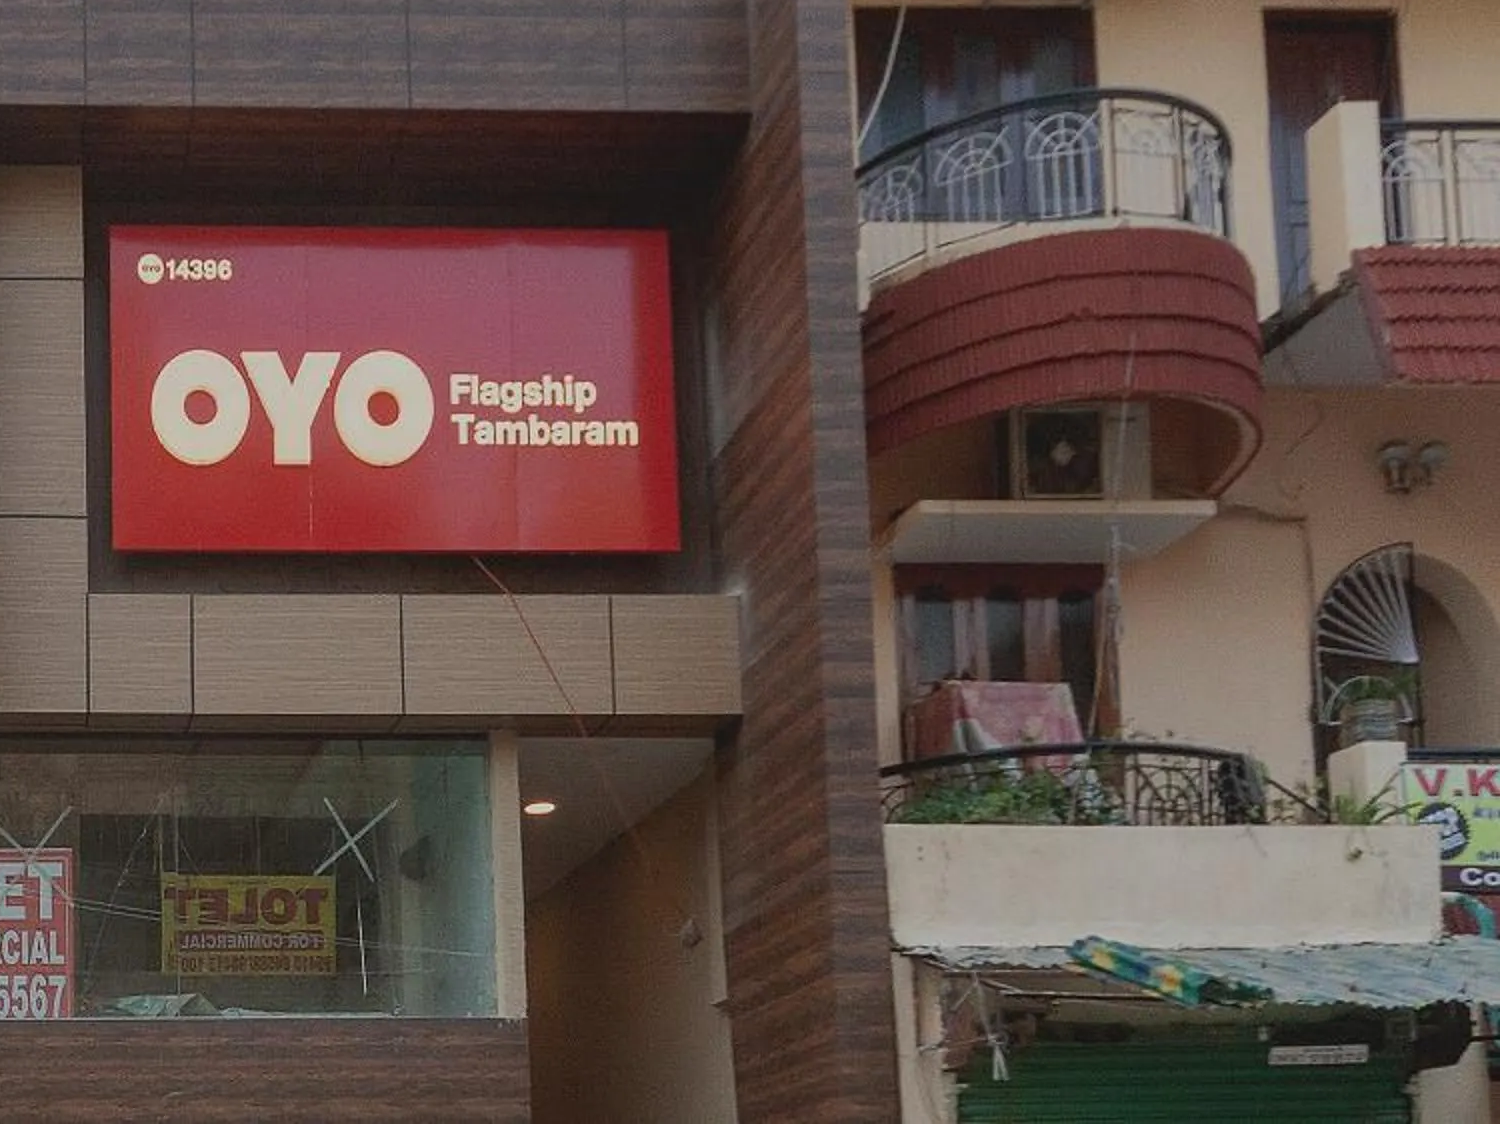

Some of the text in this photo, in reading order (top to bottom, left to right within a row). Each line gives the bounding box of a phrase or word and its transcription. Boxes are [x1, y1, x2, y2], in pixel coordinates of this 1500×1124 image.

[166, 259, 232, 280] 14396
[151, 350, 434, 467] OYO
[451, 374, 596, 412] Flagship
[451, 414, 638, 446] Tambaram
